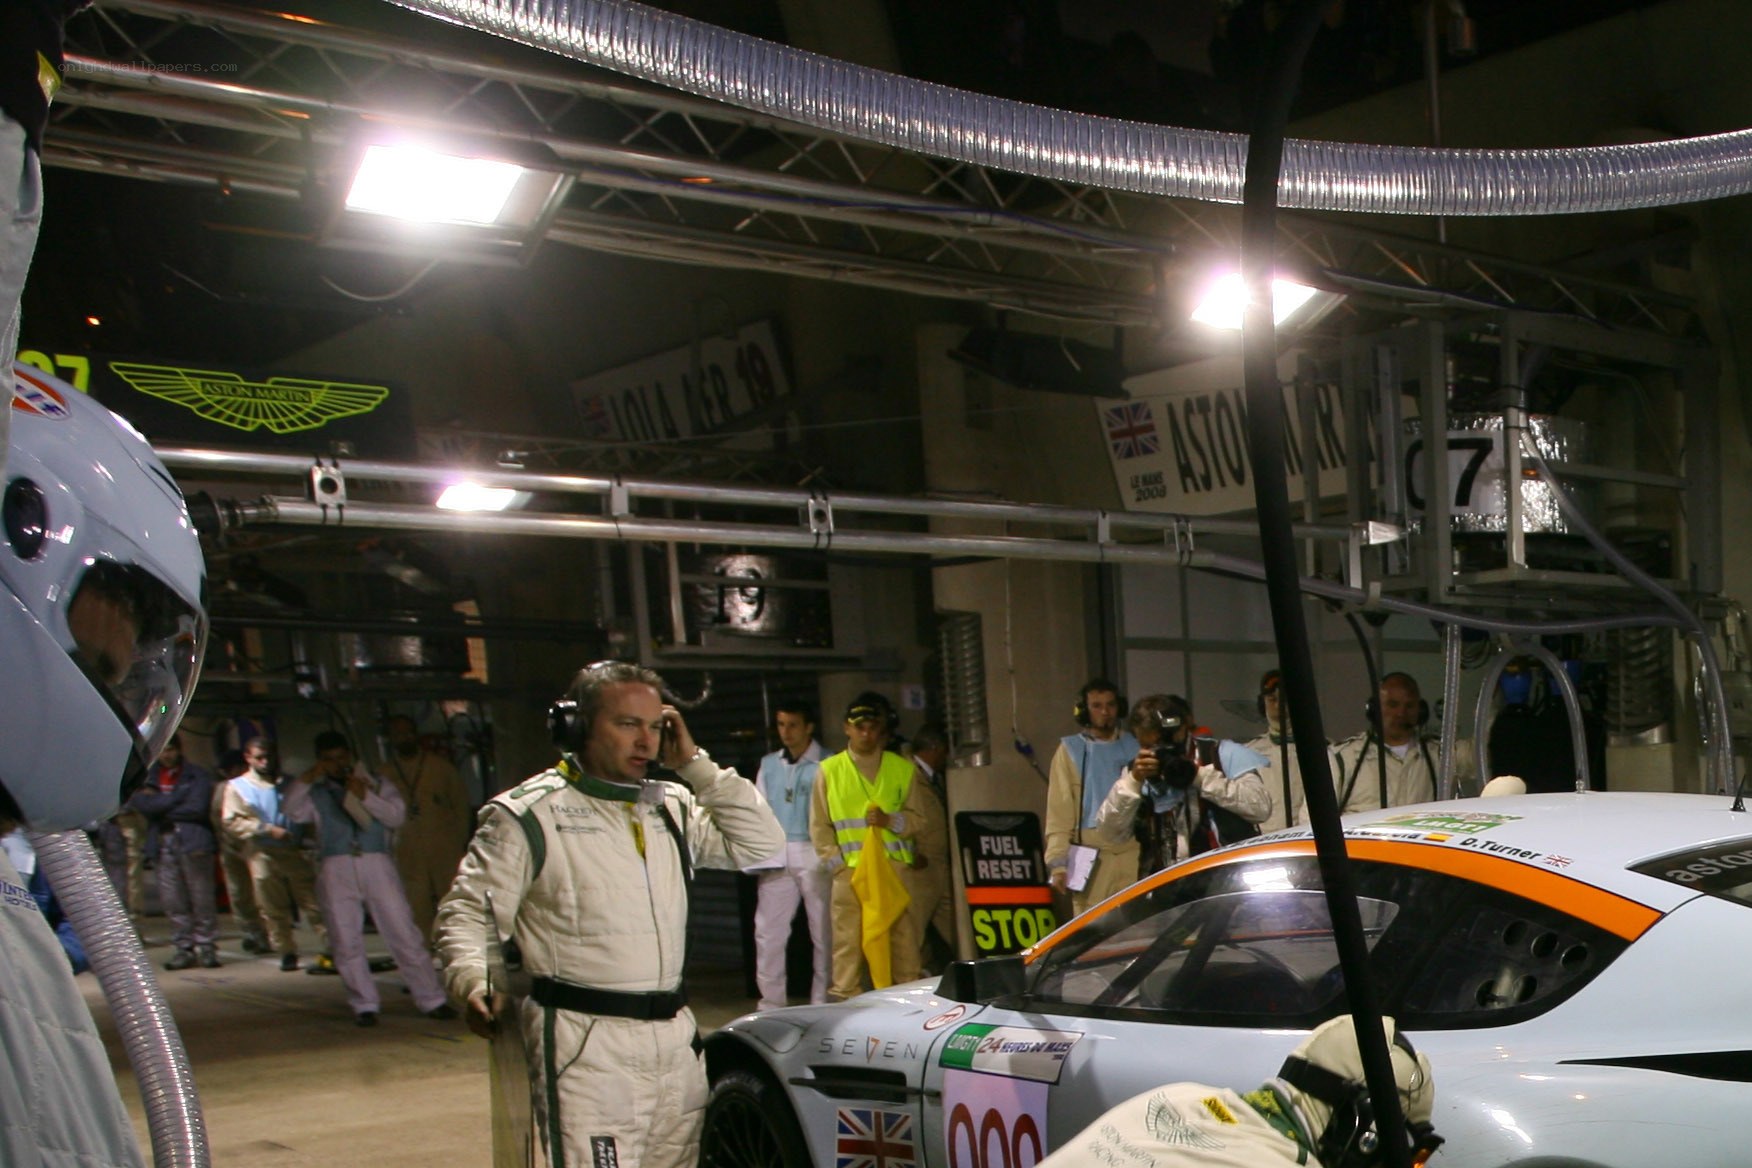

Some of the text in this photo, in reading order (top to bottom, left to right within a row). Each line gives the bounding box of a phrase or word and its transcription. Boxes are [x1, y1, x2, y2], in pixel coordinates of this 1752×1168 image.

[204, 383, 310, 402] ASTON MARTIN
[1130, 475, 1142, 489] LE
[1136, 484, 1167, 502] 2008
[979, 835, 1024, 856] FUEL
[1459, 838, 1542, 860] D.Turner
[976, 859, 1032, 880] RESET
[972, 908, 1057, 950] STOP
[819, 1036, 918, 1063] SEVEN
[977, 1037, 1073, 1054] 24 HEURES DU MANS
